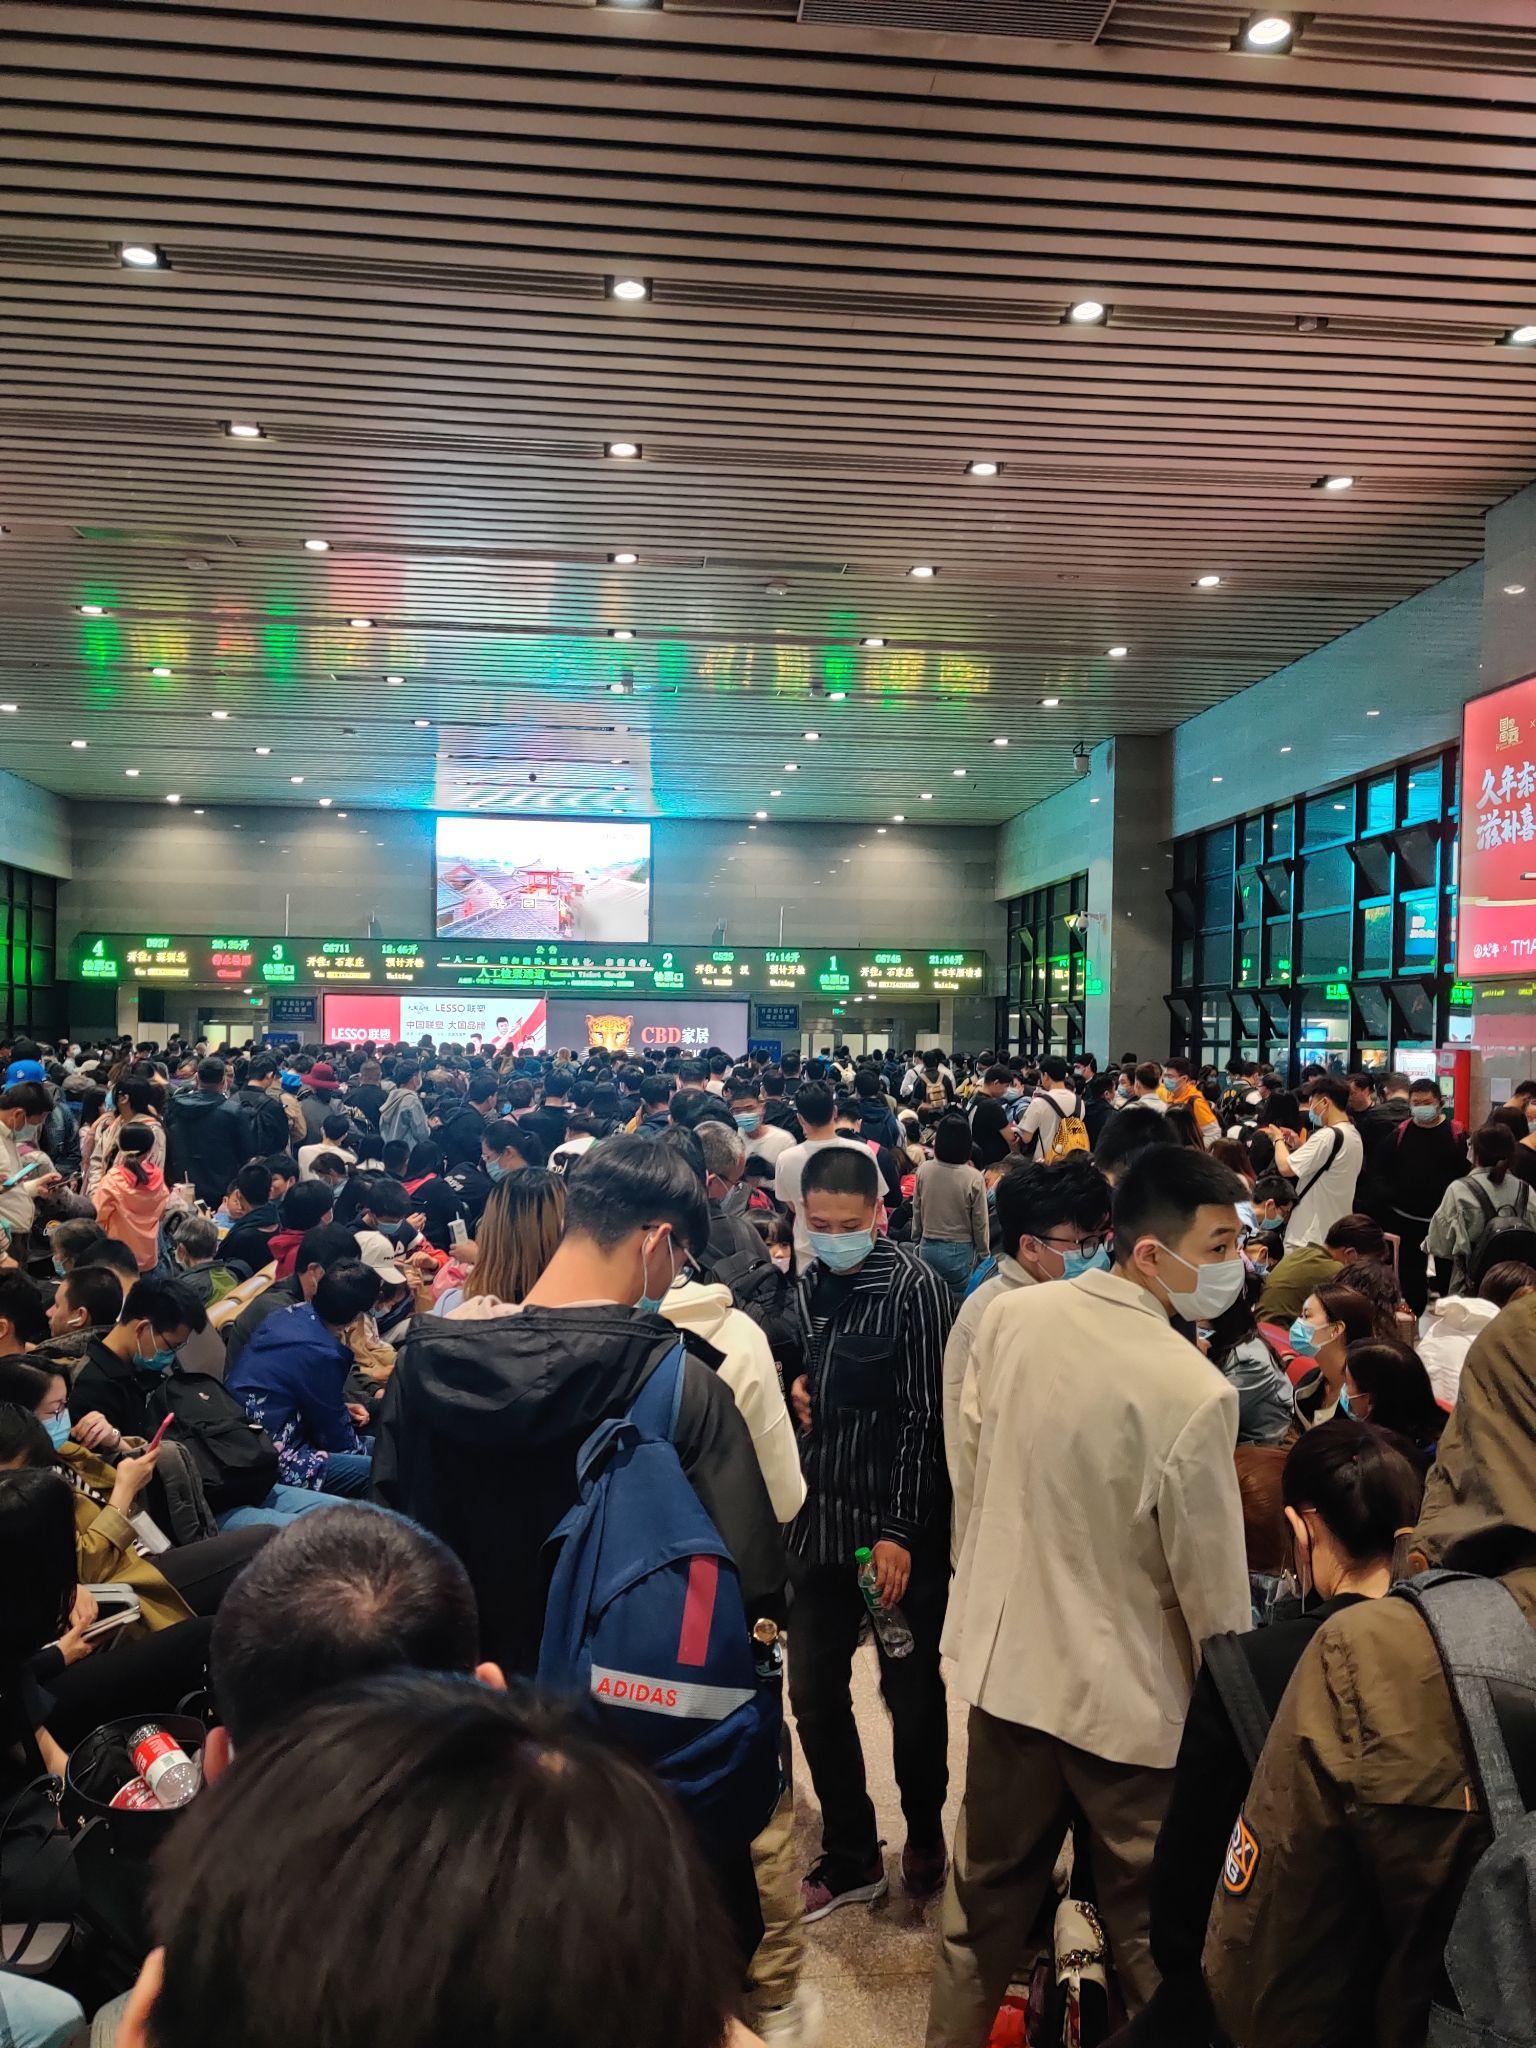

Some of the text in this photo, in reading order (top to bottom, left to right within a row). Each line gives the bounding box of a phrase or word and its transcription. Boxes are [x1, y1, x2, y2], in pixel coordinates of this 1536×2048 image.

[92, 940, 104, 956] 4
[272, 944, 283, 960] 3
[662, 953, 673, 968] 2
[829, 956, 838, 971] 1
[435, 1004, 466, 1012] LESSO
[406, 1020, 486, 1030] 中国联塑 大国品牌
[331, 1028, 367, 1041] LESSO
[596, 1676, 678, 1707] ADIDAS
